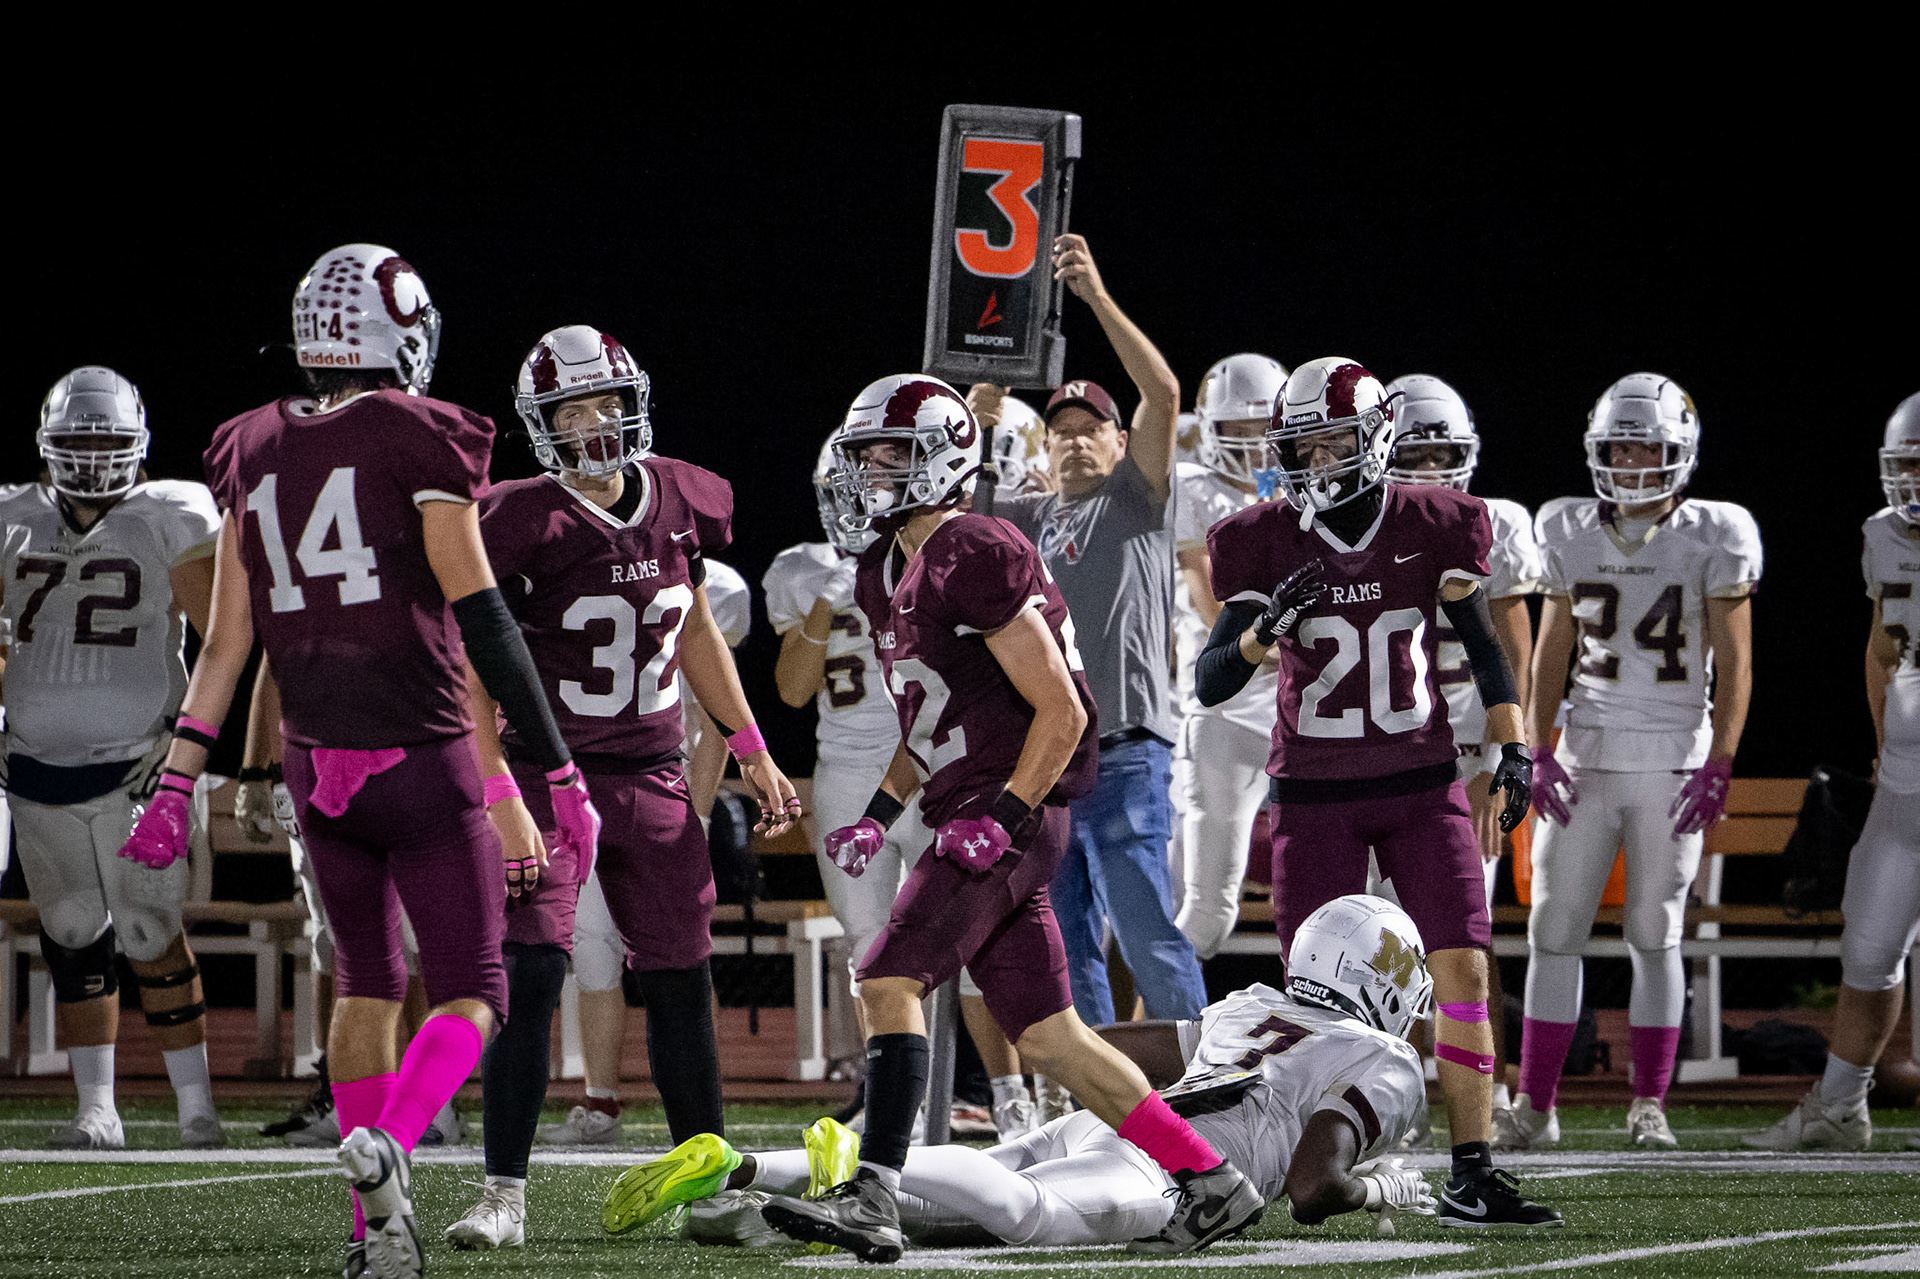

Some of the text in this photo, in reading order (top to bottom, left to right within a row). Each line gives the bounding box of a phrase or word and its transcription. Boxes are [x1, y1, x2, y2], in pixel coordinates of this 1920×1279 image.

[955, 137, 1044, 280] 3
[301, 351, 361, 365] Riddell
[1064, 382, 1088, 399] N
[1287, 412, 1318, 425] Riddell
[246, 466, 382, 614] 14
[611, 559, 660, 584] RAMS
[1331, 582, 1383, 605] RAMS
[15, 557, 142, 647] 72
[558, 582, 694, 718] 32
[1571, 581, 1688, 683] 24
[1296, 606, 1433, 739] 20
[1292, 979, 1330, 999] schutt
[1235, 1013, 1316, 1071] 7
